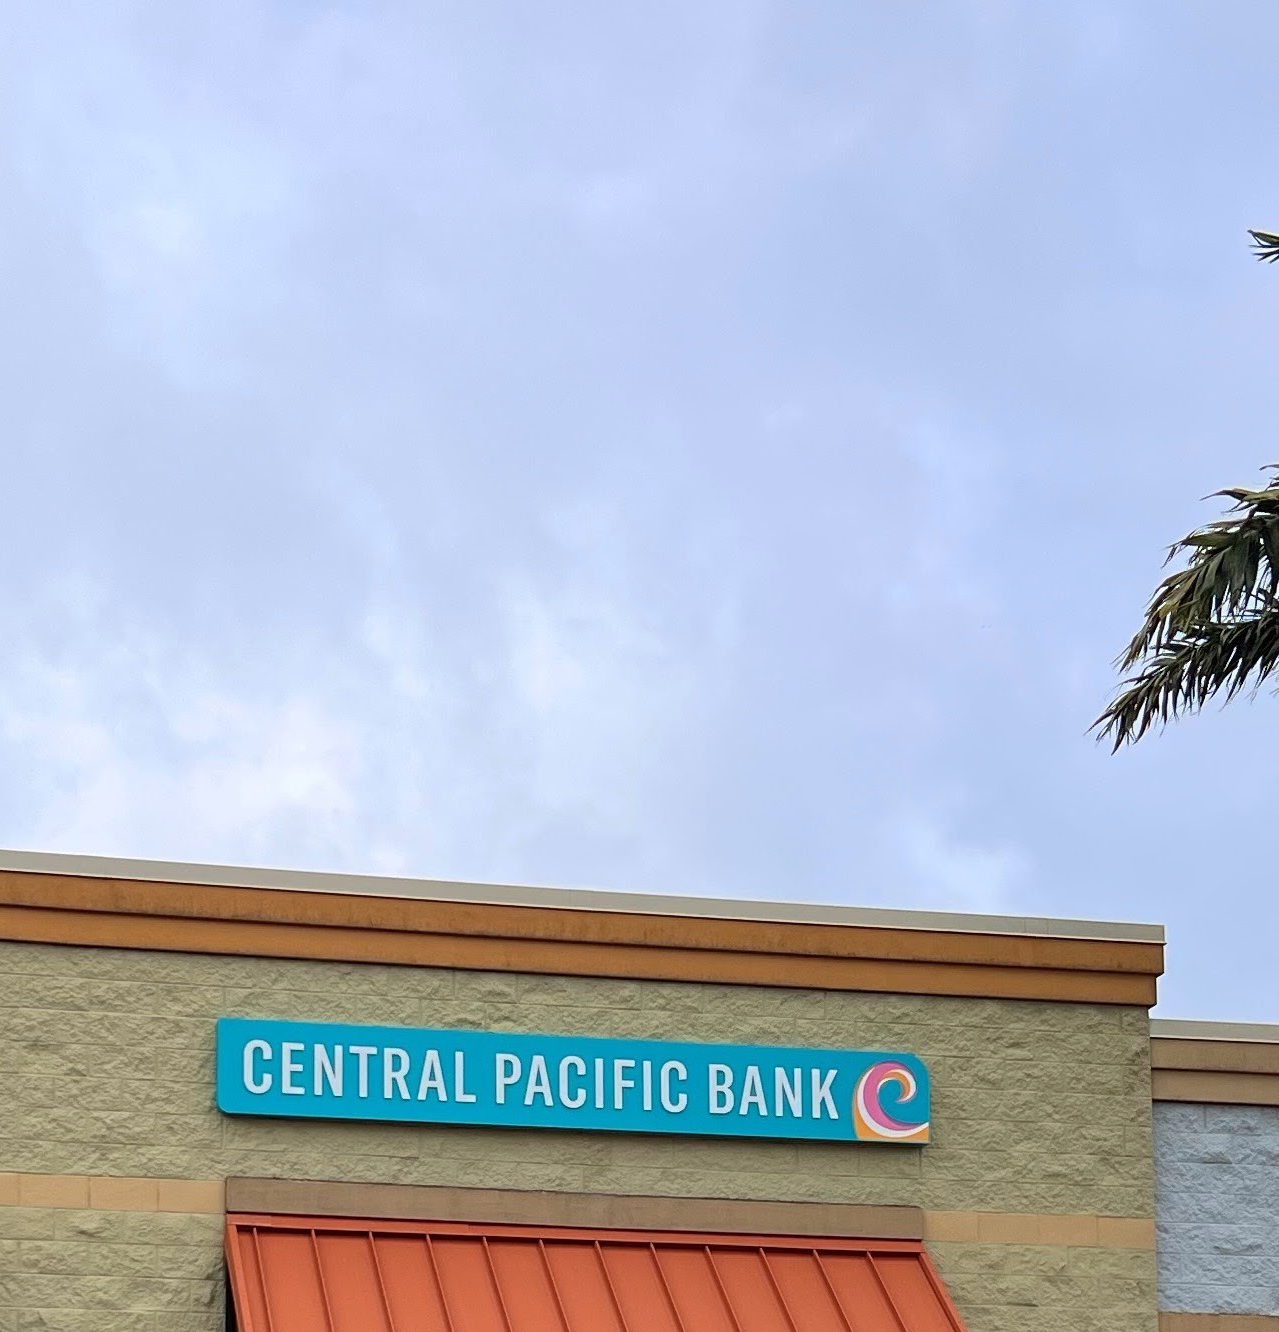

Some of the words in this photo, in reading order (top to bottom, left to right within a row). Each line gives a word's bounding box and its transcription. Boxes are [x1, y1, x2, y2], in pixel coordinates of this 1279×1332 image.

[242, 1038, 477, 1104] CENTRAL
[495, 1053, 689, 1114] PACIFIC
[708, 1063, 840, 1120] BANK
